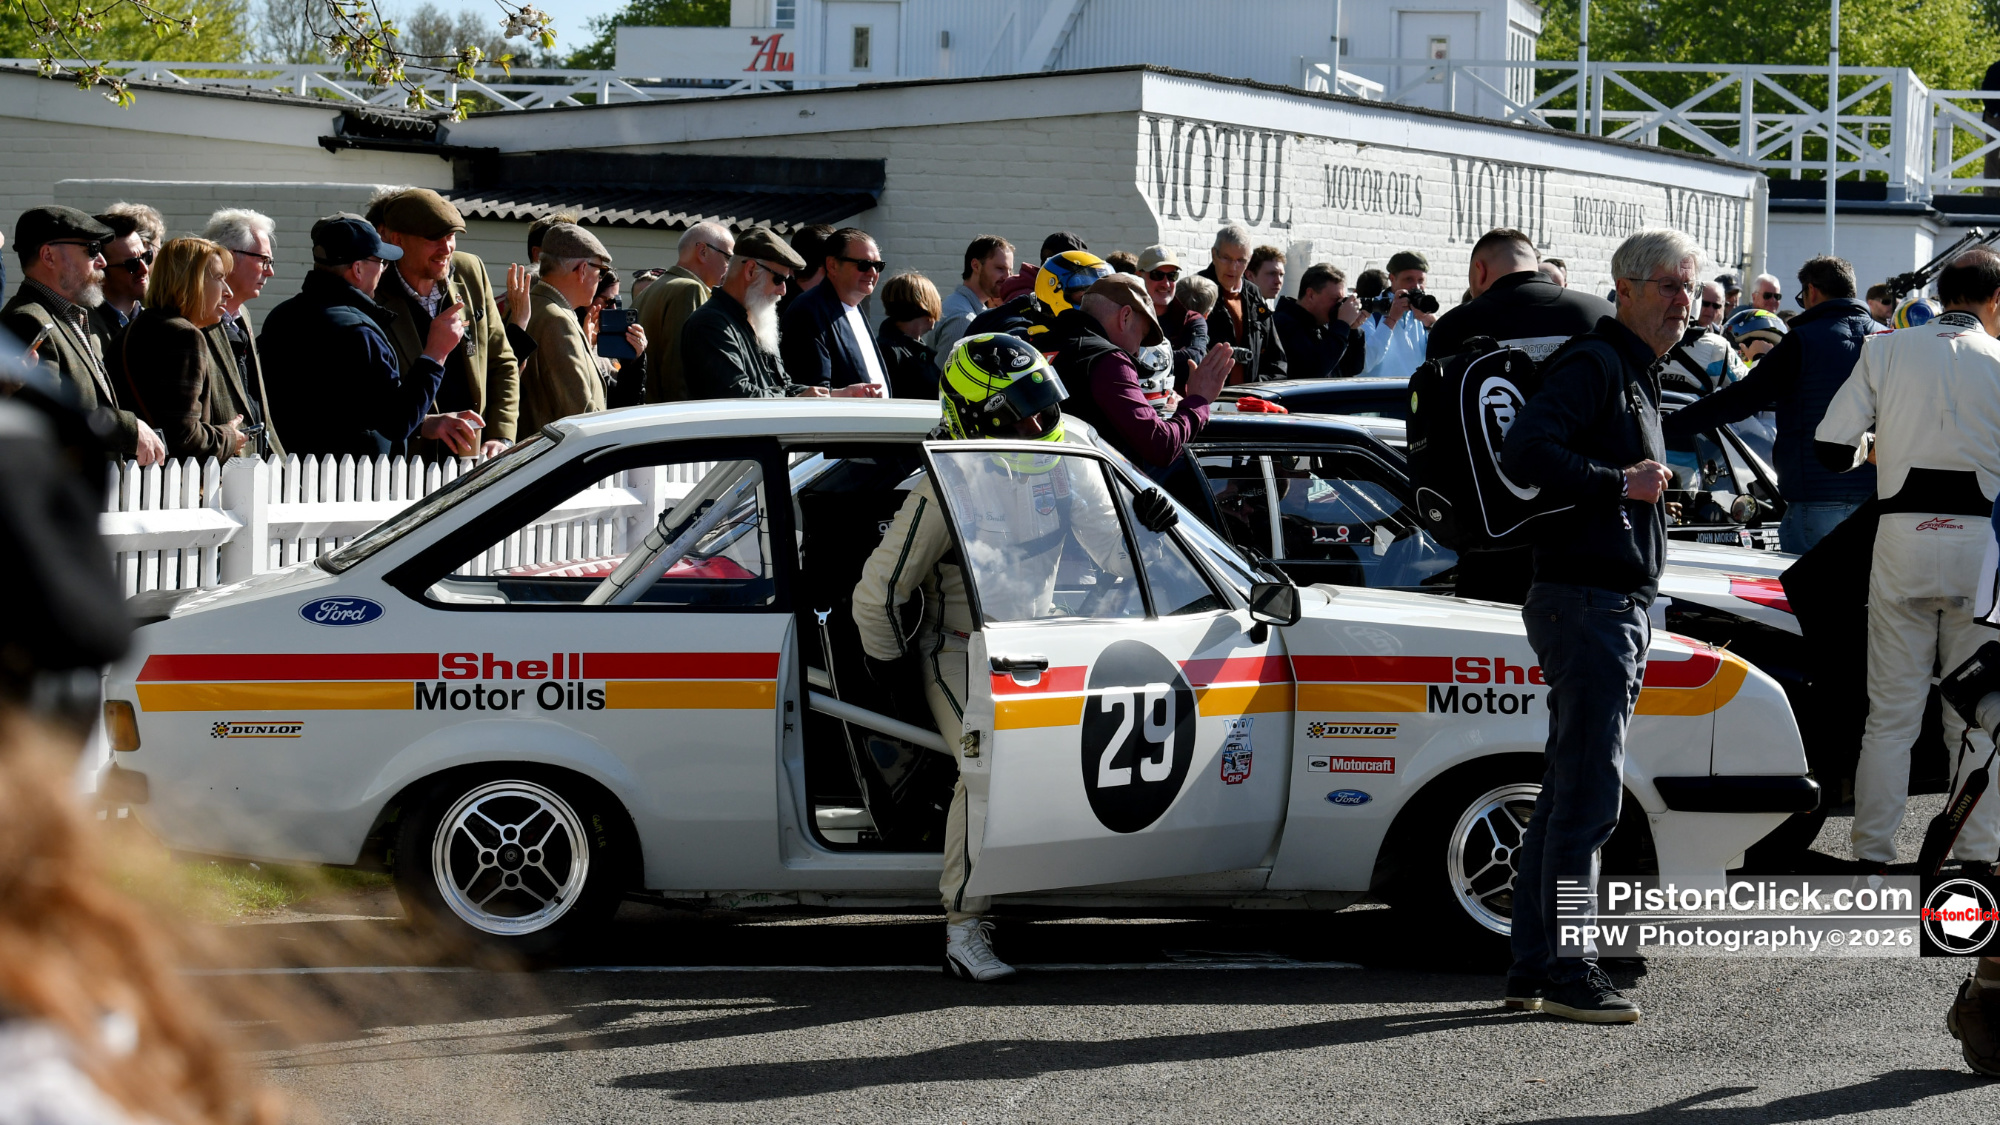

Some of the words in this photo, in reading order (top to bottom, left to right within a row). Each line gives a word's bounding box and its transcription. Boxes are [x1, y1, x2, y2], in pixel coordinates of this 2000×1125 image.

[1147, 116, 1292, 229] MOTUL
[1323, 164, 1383, 213] MOTOR
[1386, 171, 1423, 218] OILS
[1448, 157, 1552, 249] MOTUL
[1572, 195, 1617, 236] MOTOR
[1696, 533, 1713, 543] JOHN
[1714, 533, 1740, 544] MORRIS
[315, 601, 367, 621] Ford
[442, 653, 580, 680] Shell
[1455, 656, 1549, 685] She
[415, 681, 525, 710] Motor
[536, 681, 606, 711] Oils
[1428, 685, 1535, 714] Motor
[231, 726, 302, 734] DUNLOP
[1097, 682, 1176, 788] 29
[1326, 726, 1397, 735] DUNLOP
[1332, 758, 1393, 772] Motorcraft
[1334, 792, 1362, 805] Ford
